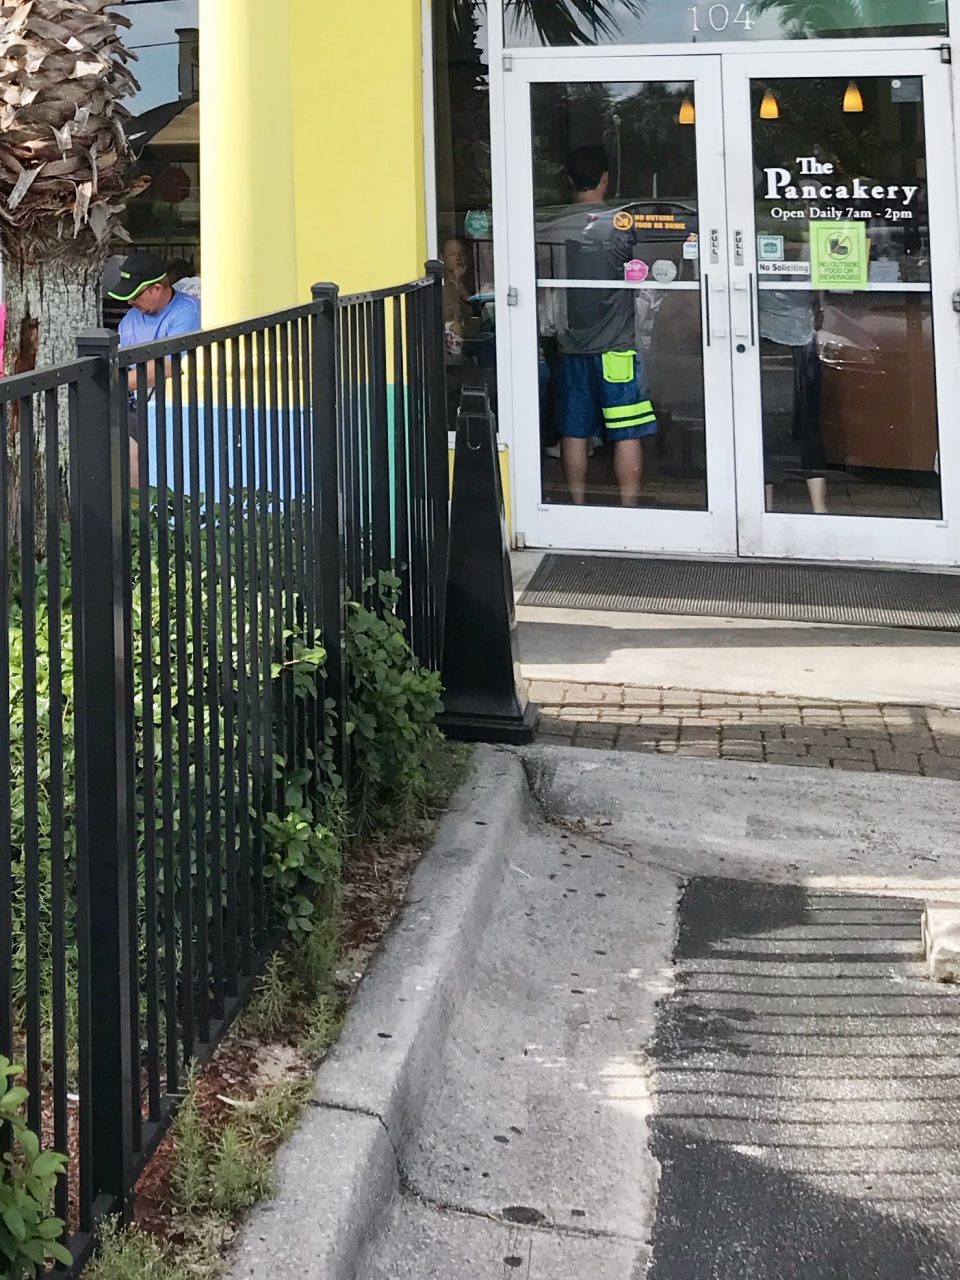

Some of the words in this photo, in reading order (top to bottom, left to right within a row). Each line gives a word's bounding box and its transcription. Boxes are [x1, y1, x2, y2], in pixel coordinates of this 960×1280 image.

[687, 3, 756, 32] 104
[795, 156, 834, 175] The
[763, 167, 918, 206] Pancakery
[646, 214, 675, 222] OUTSIDE
[770, 206, 805, 221] Open
[809, 206, 843, 221] Daily
[845, 207, 873, 219] 7am
[884, 207, 913, 221] 2pm
[760, 263, 770, 271] No
[772, 263, 809, 273] Soliciting
